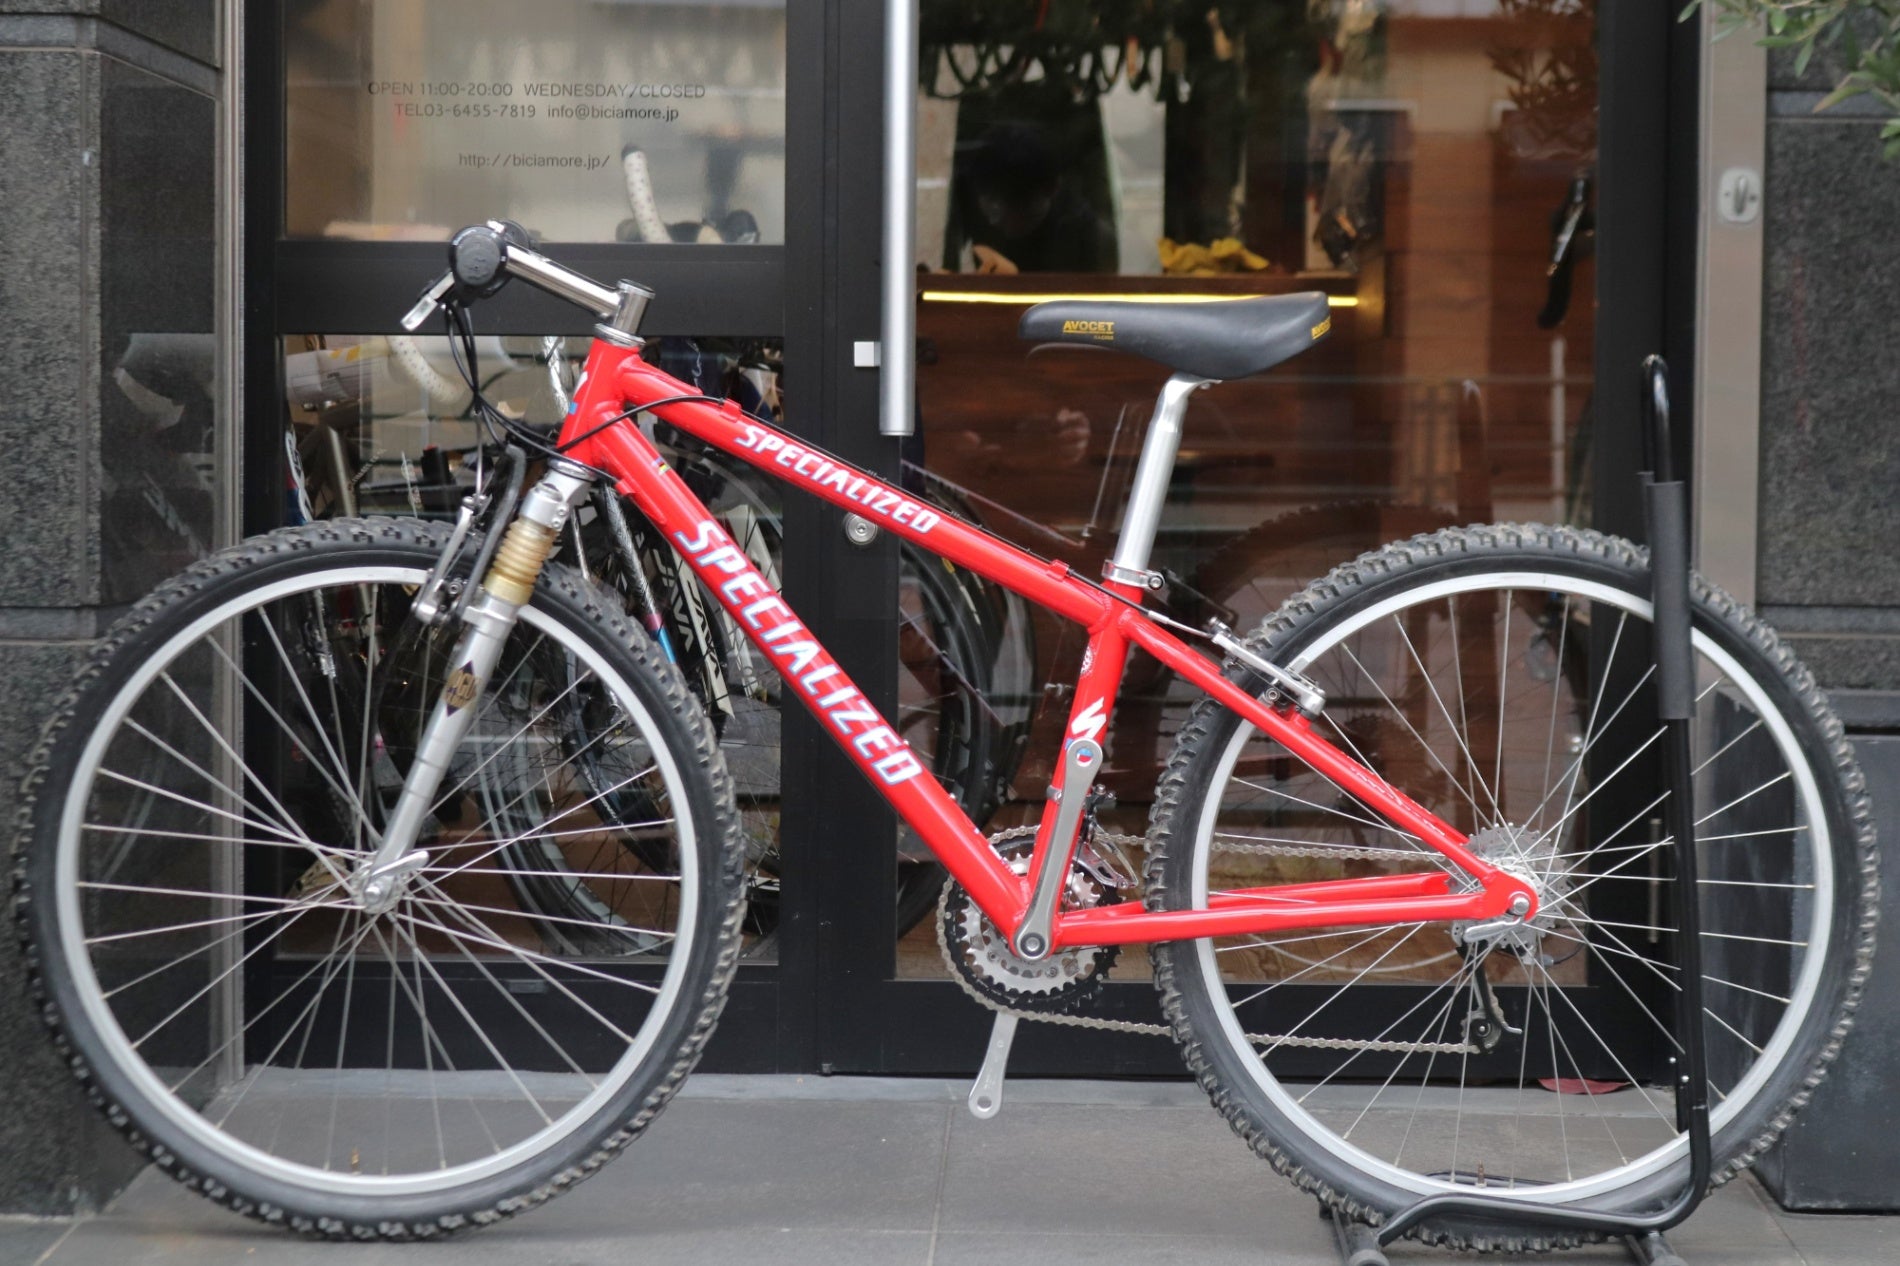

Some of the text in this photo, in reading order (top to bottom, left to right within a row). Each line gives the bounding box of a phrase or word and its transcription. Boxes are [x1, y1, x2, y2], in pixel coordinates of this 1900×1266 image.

[368, 82, 706, 99] OPEN 11:00-20:00 WEDNESDAY/CLOSED
[395, 103, 680, 121] TEL03-6455-7819 info@biciamore.jp
[458, 153, 611, 170] http://biciamore.jp/
[1063, 320, 1115, 332] AVOCET
[734, 424, 942, 535] SPECIALIZED
[673, 519, 924, 788] SPECIALIZED
